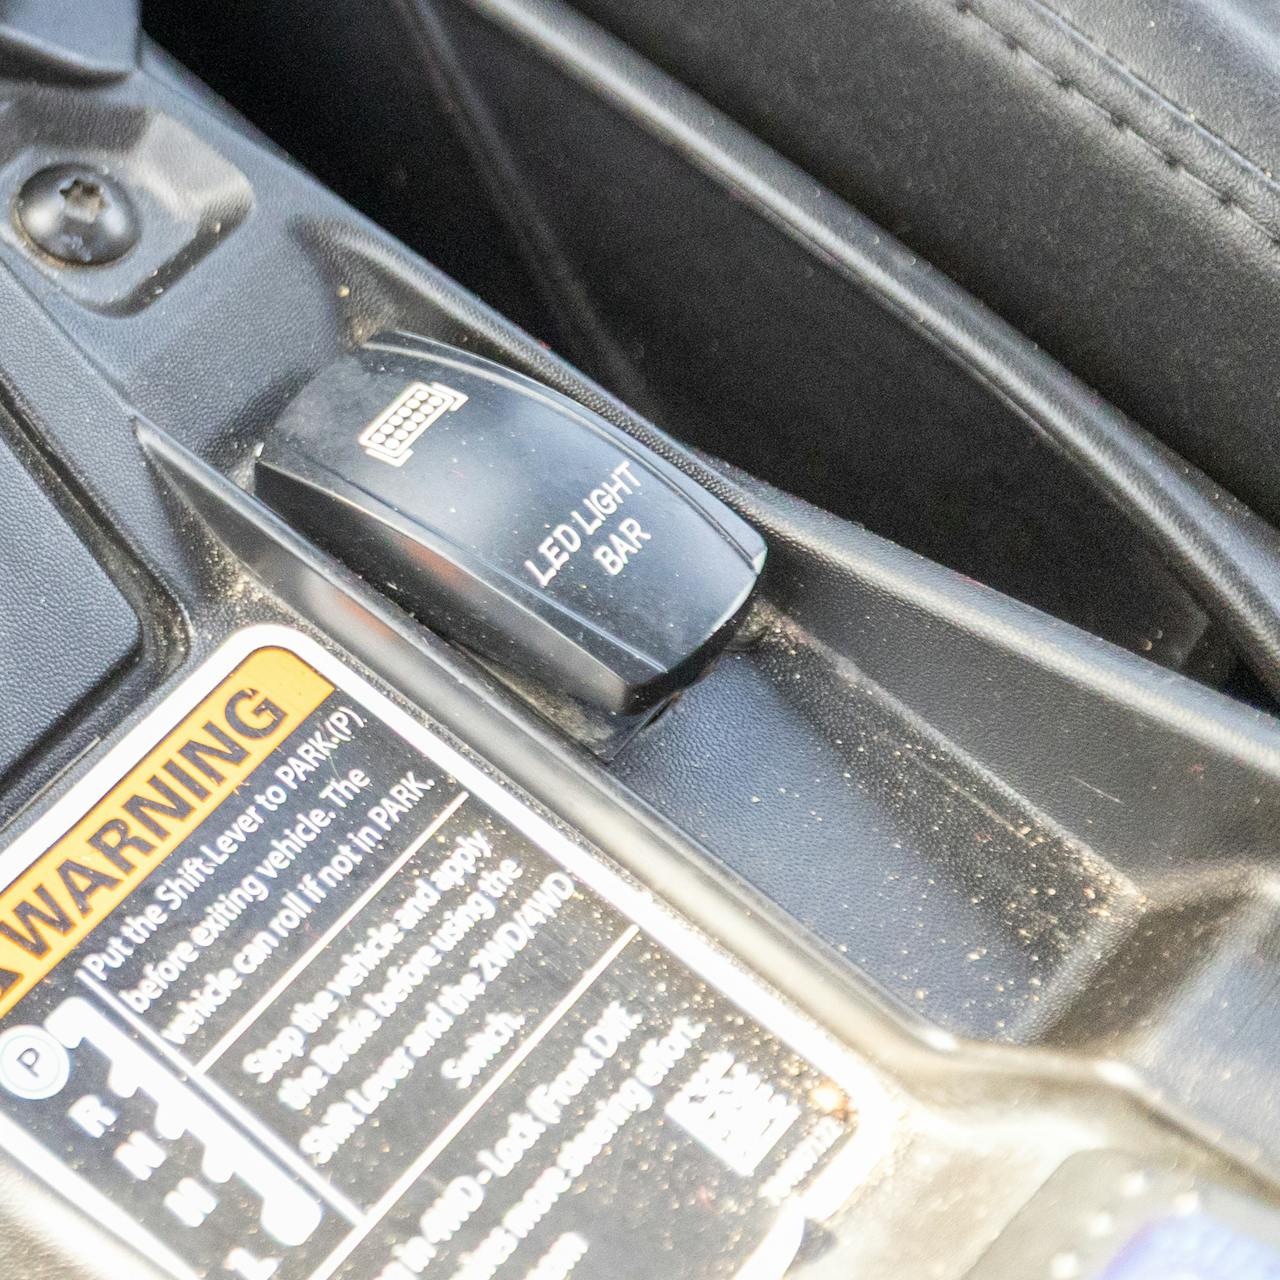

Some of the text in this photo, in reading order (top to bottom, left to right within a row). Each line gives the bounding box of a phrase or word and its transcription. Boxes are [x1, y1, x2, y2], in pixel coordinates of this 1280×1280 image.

[525, 459, 641, 588] LED LIGHT
[592, 516, 652, 577] BAR
[82, 937, 133, 980] Put
[120, 905, 168, 943] the
[155, 858, 214, 910] Shift
[200, 806, 264, 866] Lever
[254, 785, 286, 811] to
[119, 769, 370, 1013] before exiting vehicle. The
[161, 772, 434, 1044] vehicle can roll if not in PARK.
[243, 830, 493, 1083] Stop the vehicle and apply
[404, 1002, 453, 1057] and
[437, 973, 485, 1015] the
[469, 872, 577, 981] 2WD/4WD
[16, 1046, 41, 1079] P
[278, 1066, 328, 1110] the
[363, 946, 441, 1017] before
[430, 887, 495, 951] using
[478, 859, 523, 897] the
[67, 1094, 119, 1138] R
